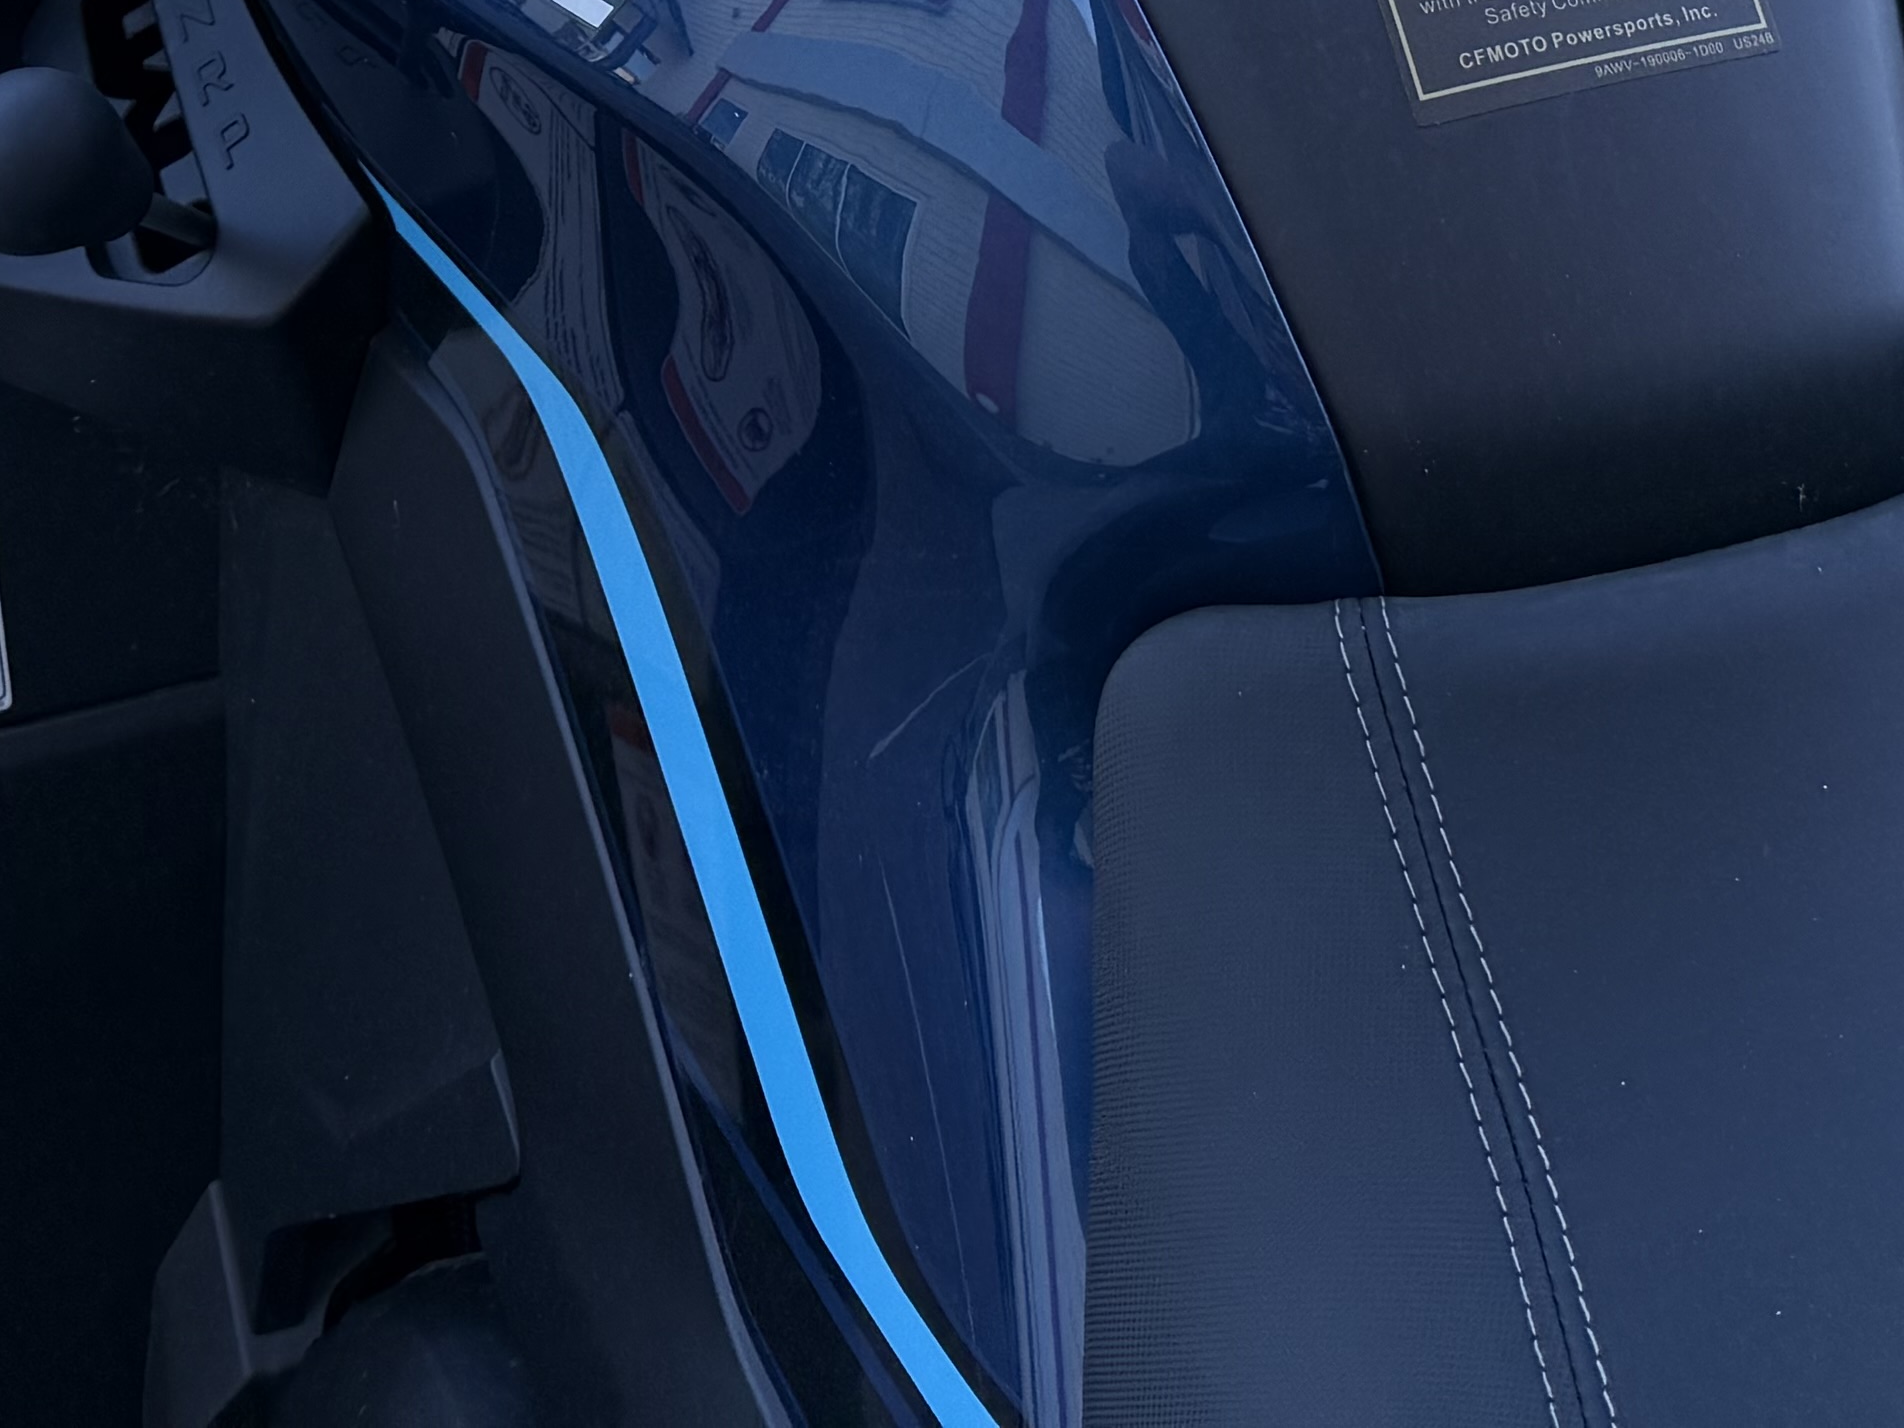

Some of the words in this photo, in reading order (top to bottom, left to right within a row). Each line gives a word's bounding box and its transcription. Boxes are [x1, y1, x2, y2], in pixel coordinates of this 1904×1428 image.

[1458, 34, 1548, 69] CFMOTO
[1550, 11, 1681, 49] Powersports,
[1680, 5, 1718, 22] Inc.
[195, 49, 236, 109] R
[219, 110, 252, 171] P
